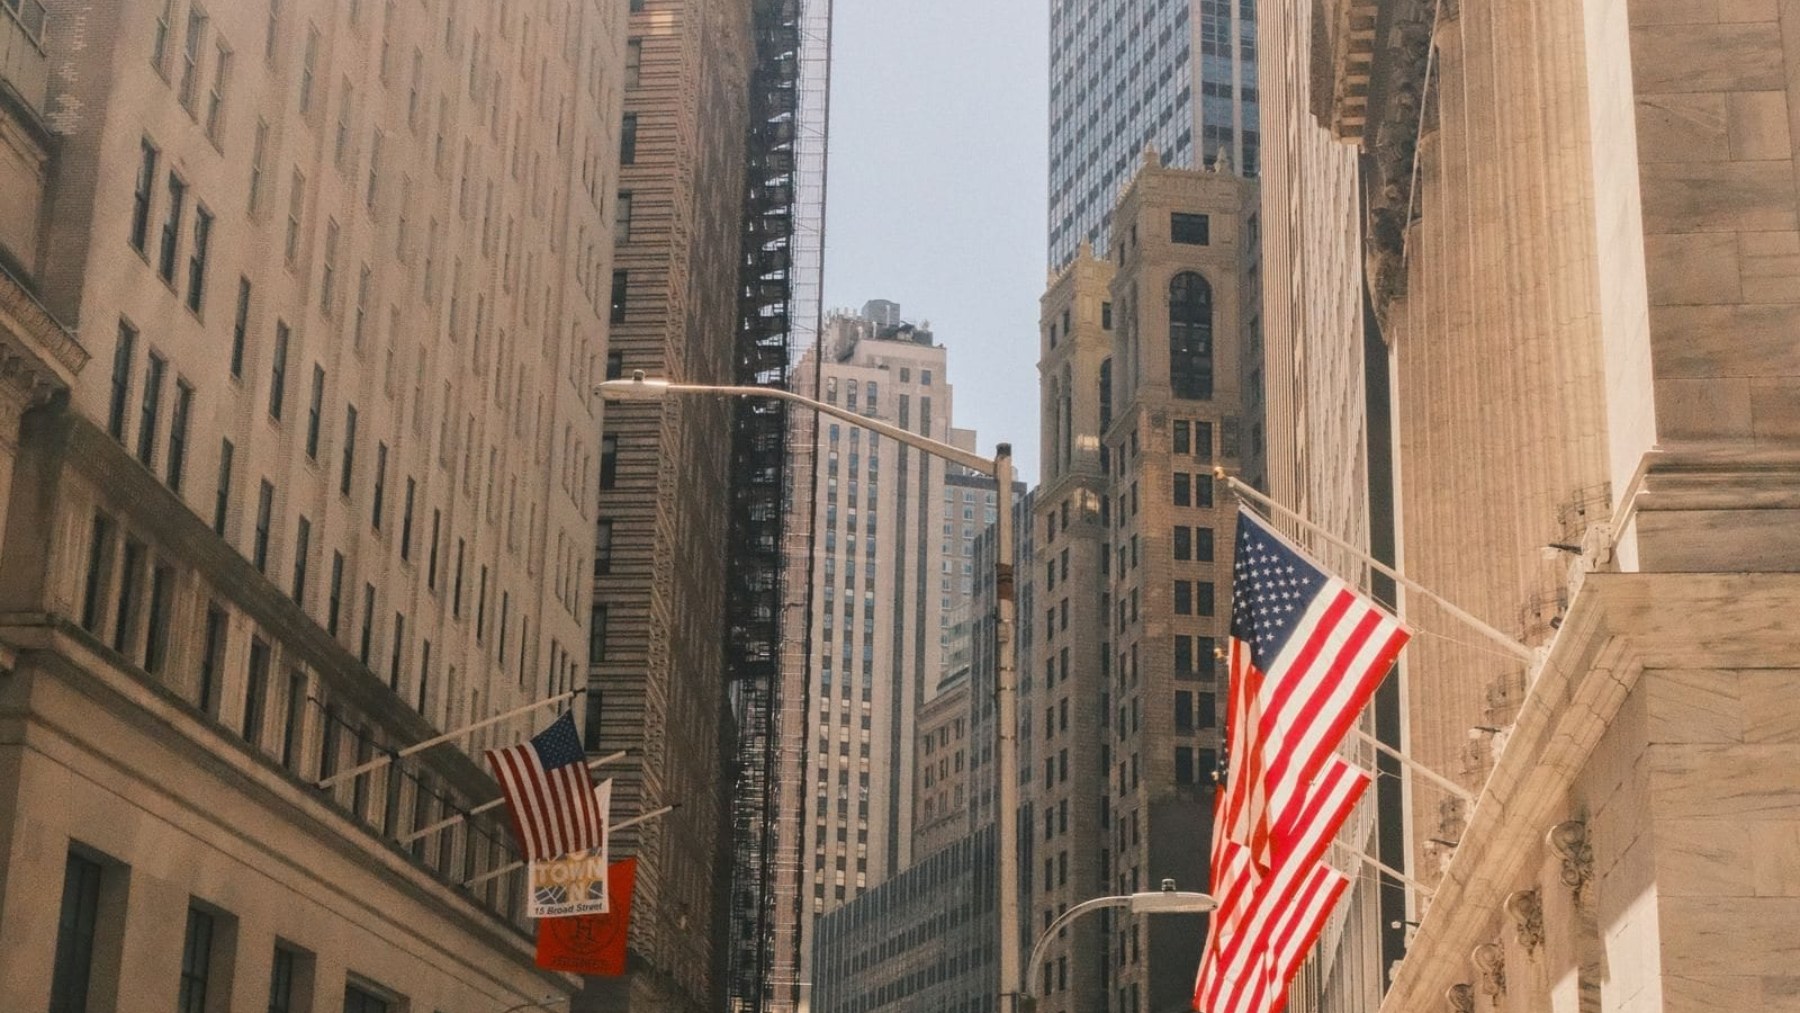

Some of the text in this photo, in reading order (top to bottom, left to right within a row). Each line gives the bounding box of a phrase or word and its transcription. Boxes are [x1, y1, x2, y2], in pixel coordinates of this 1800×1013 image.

[535, 857, 603, 883] TOWN
[535, 902, 603, 915] 15 Broad Street
